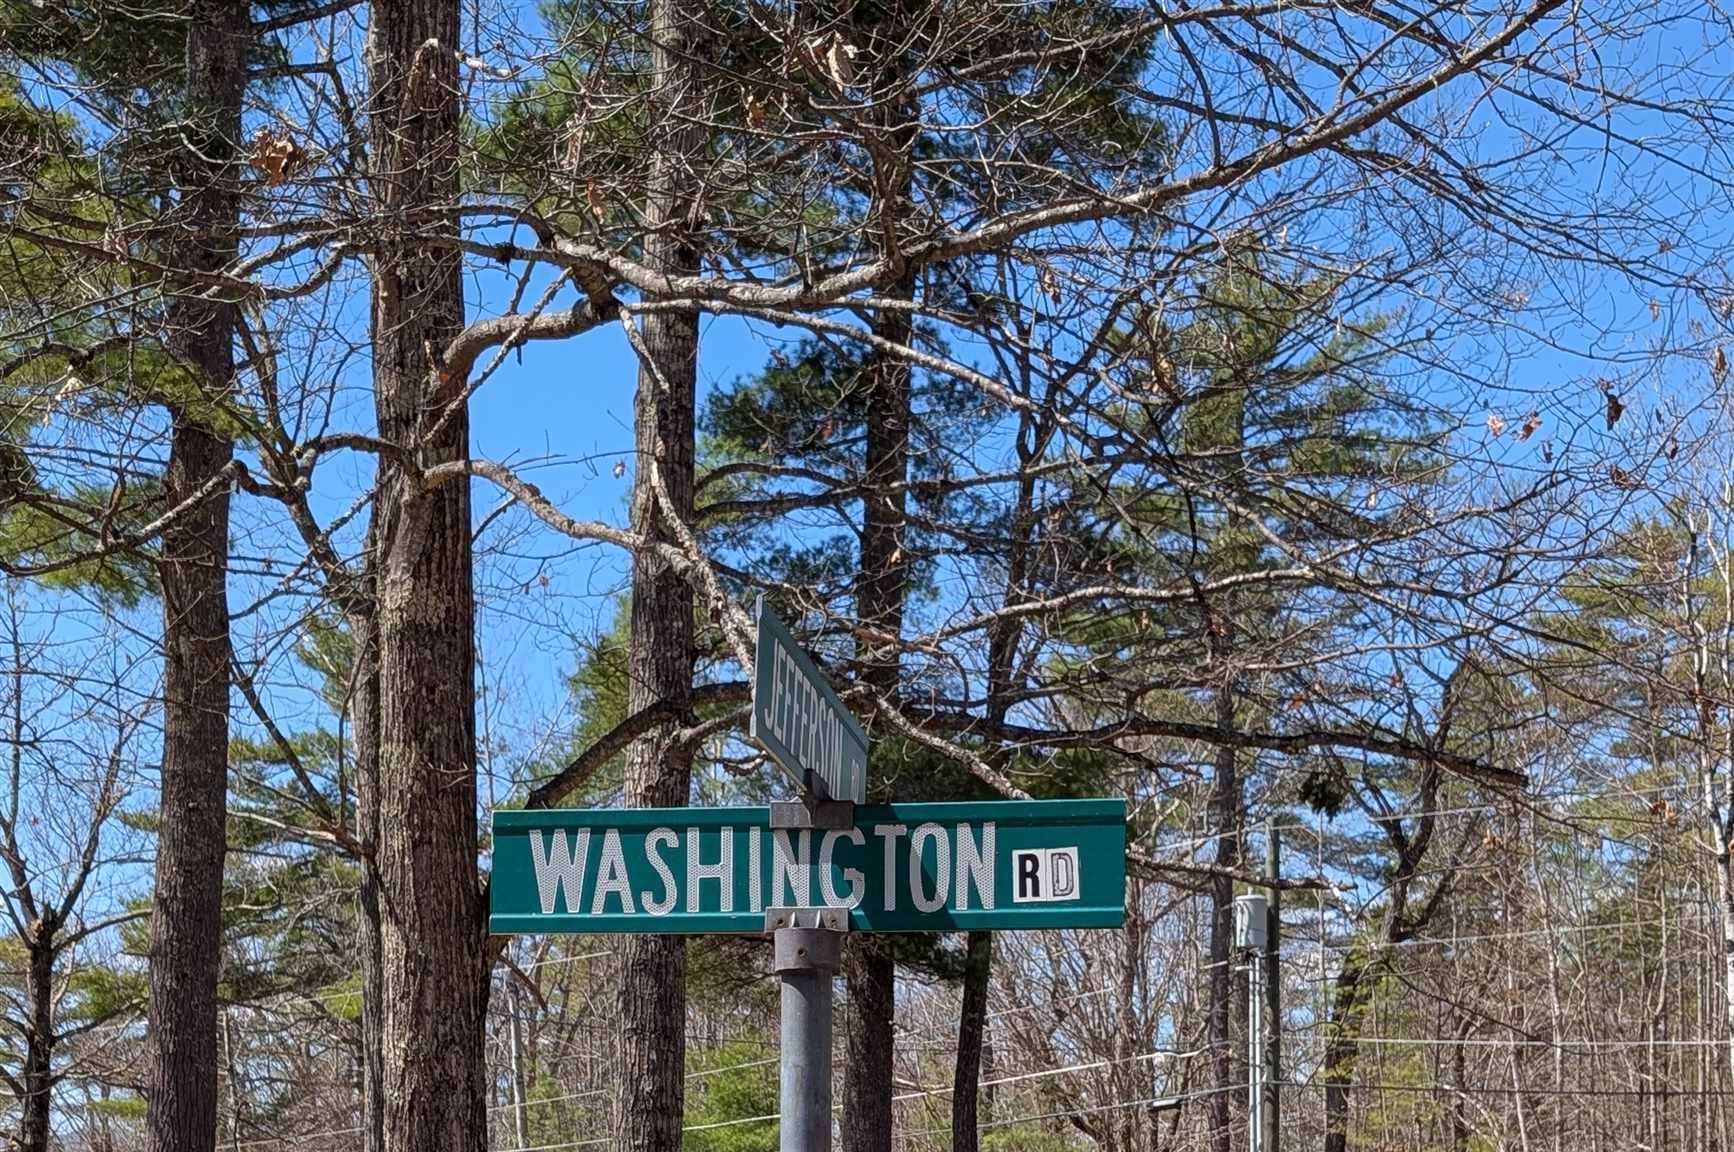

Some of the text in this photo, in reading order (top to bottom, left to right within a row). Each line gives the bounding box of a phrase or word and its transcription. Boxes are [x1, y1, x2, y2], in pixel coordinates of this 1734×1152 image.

[764, 637, 844, 800] JEFFERSON
[528, 821, 1076, 916] WASHINGTON RD
